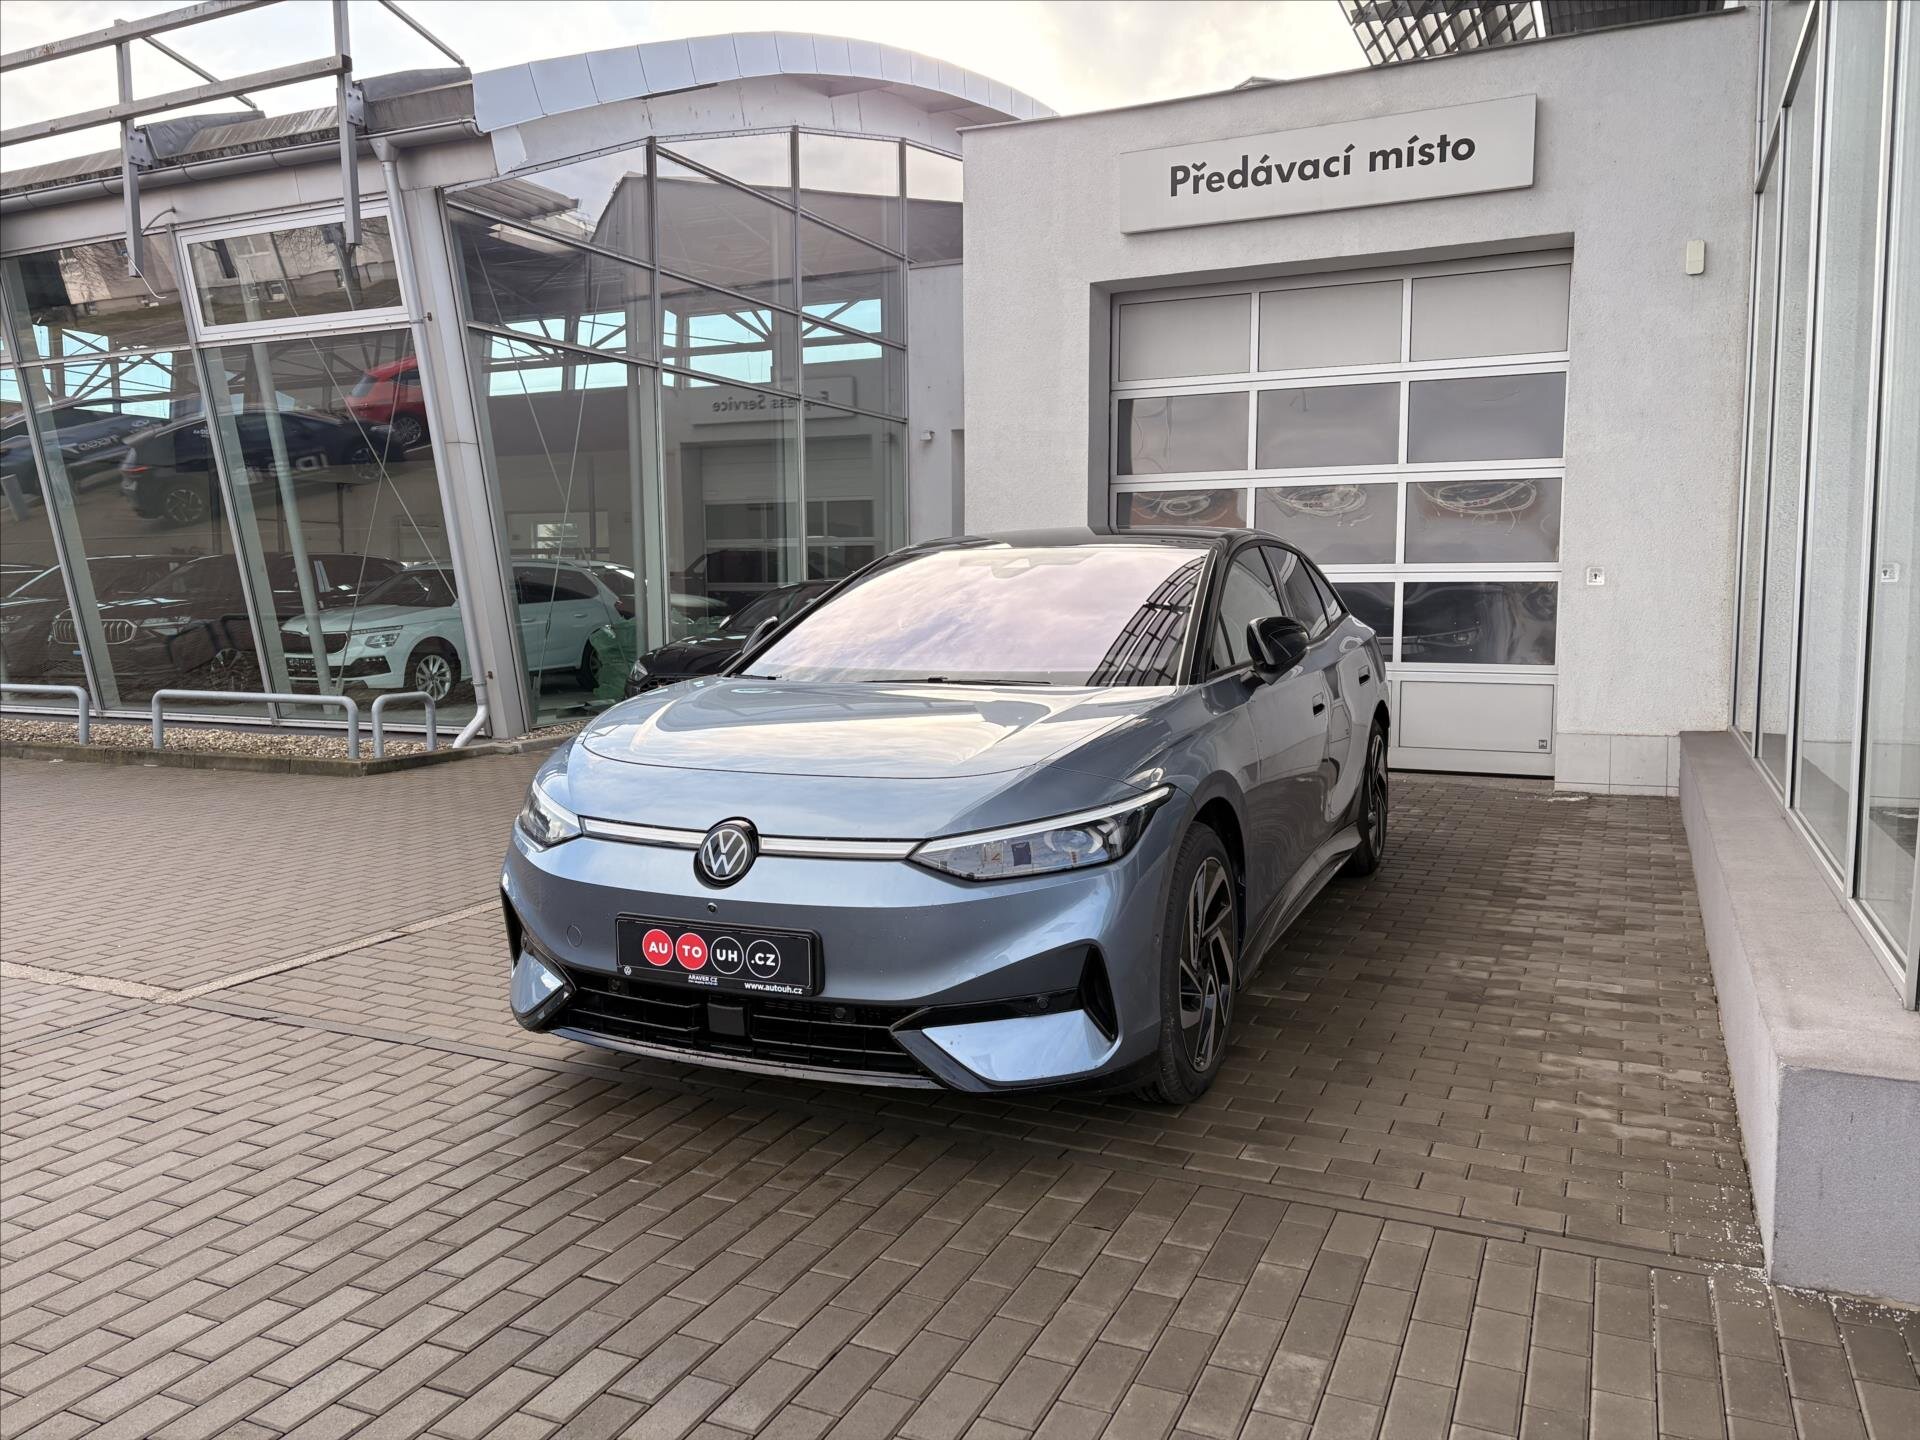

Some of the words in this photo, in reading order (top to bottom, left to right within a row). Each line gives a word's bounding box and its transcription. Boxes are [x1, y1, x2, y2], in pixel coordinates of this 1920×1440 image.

[1171, 143, 1356, 197] Předávací
[1369, 134, 1476, 172] místo
[648, 941, 669, 955] AU
[682, 945, 703, 958] TO
[716, 949, 738, 962] UH
[744, 982, 803, 995] www.autouh.cz
